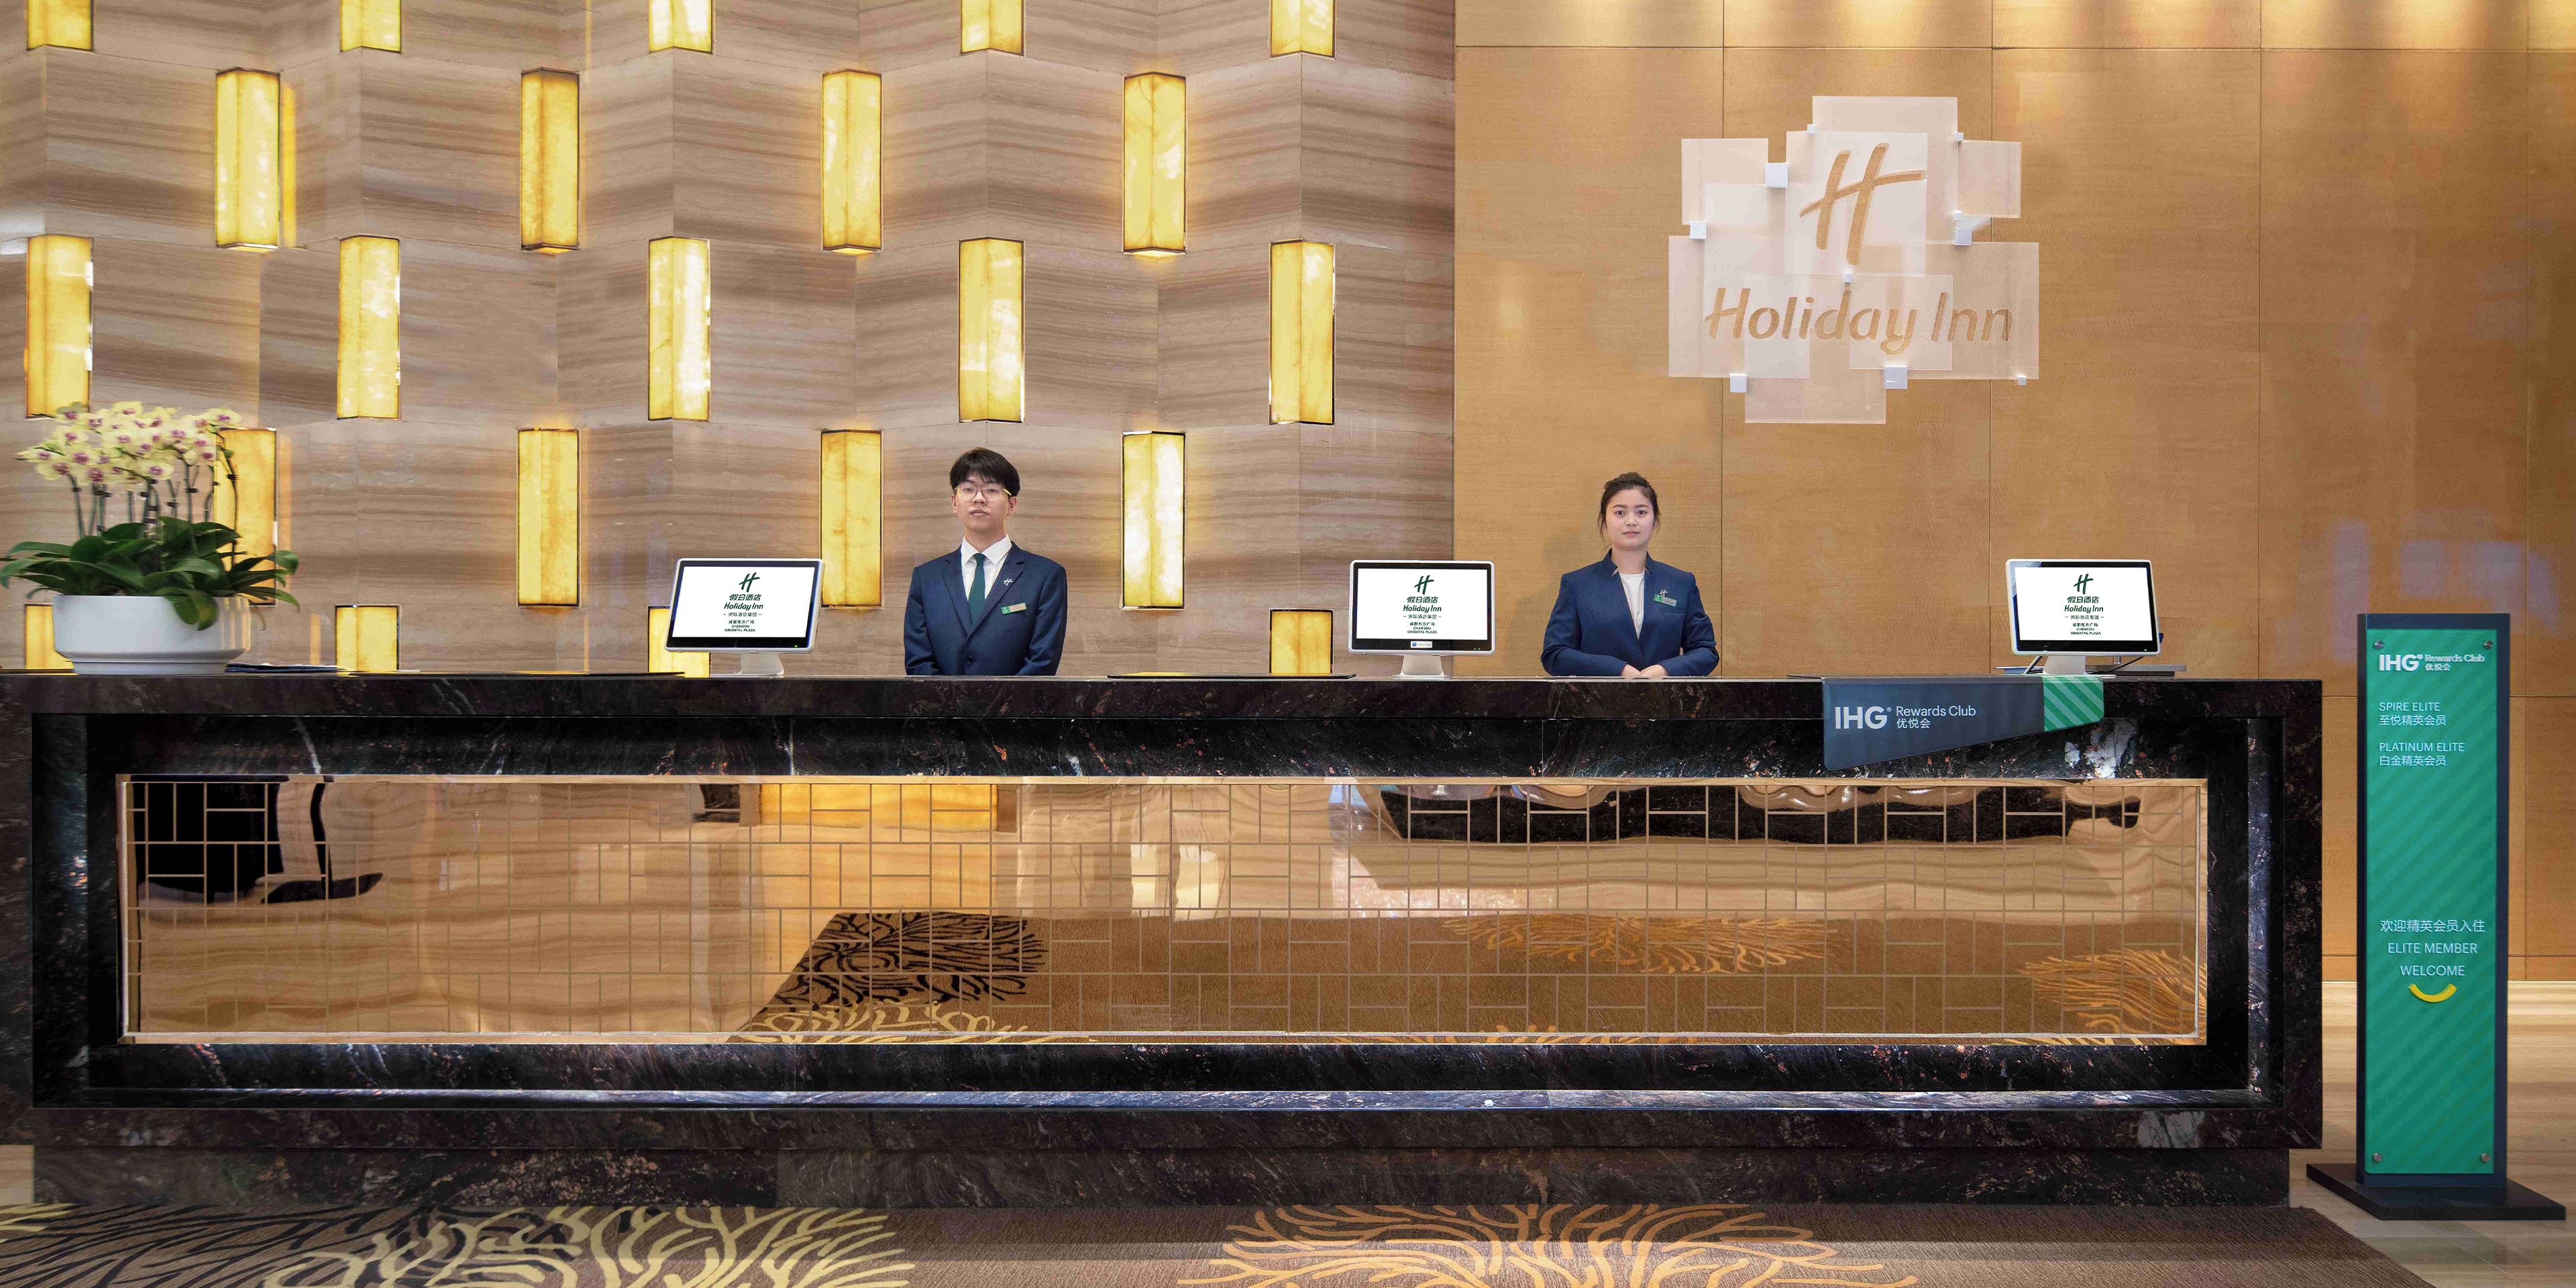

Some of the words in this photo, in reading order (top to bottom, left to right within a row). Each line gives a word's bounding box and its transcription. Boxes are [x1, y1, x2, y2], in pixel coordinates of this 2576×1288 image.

[1704, 283, 1917, 356] Holiday
[1931, 292, 2014, 342] Inn
[2067, 596, 2099, 604] 假日酒店
[724, 602, 752, 611] Holiday
[1403, 604, 1430, 613] Holiday
[2065, 604, 2092, 614] Holiday
[2425, 654, 2463, 662] Rewards
[2463, 654, 2485, 662] Club
[1896, 706, 1947, 717] Rewards
[1949, 706, 1976, 717] Club
[2379, 702, 2410, 712] SPIRE
[2412, 702, 2440, 712] ELITE
[1896, 718, 1931, 729] 优悦会
[2379, 714, 2447, 726] 至悦精英会员
[2379, 742, 2433, 752] PLATINUM
[2436, 742, 2465, 752] ELITE
[2379, 755, 2447, 766] 白金精英会员
[2379, 919, 2485, 932] 欢迎精英会员入住
[2387, 943, 2420, 954] ELITE
[2424, 943, 2478, 954] MEMBER
[2400, 965, 2465, 976] WELCOME
